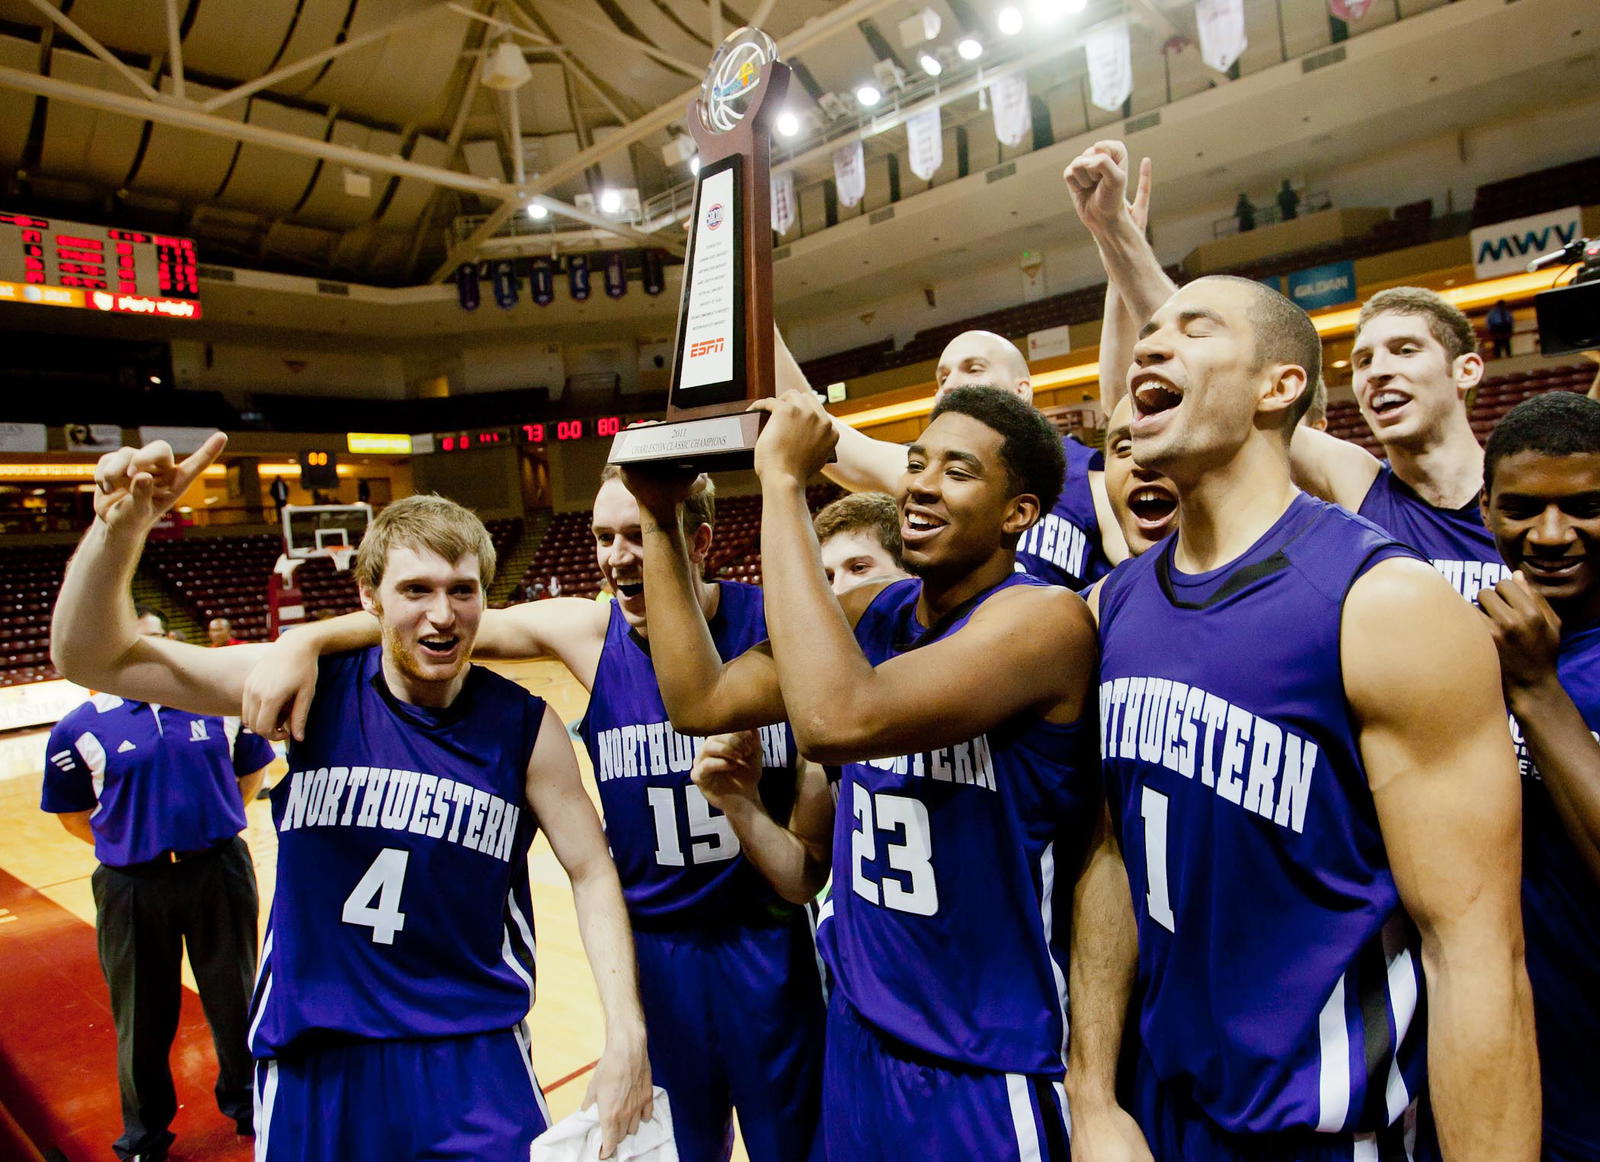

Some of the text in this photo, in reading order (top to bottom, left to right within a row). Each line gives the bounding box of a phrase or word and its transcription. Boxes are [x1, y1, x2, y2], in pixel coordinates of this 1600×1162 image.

[1478, 221, 1577, 264] MWV
[690, 337, 725, 358] ESPN
[523, 424, 544, 442] 73
[671, 428, 687, 439] 2011
[690, 435, 728, 449] CHAMPIONS
[191, 719, 207, 739] N
[597, 720, 788, 783] NORTHWRN
[279, 766, 520, 863] NORTHWESTERN
[647, 784, 740, 867] 15
[851, 781, 939, 917] 23
[1141, 785, 1175, 934] 1
[341, 847, 410, 945] 4
